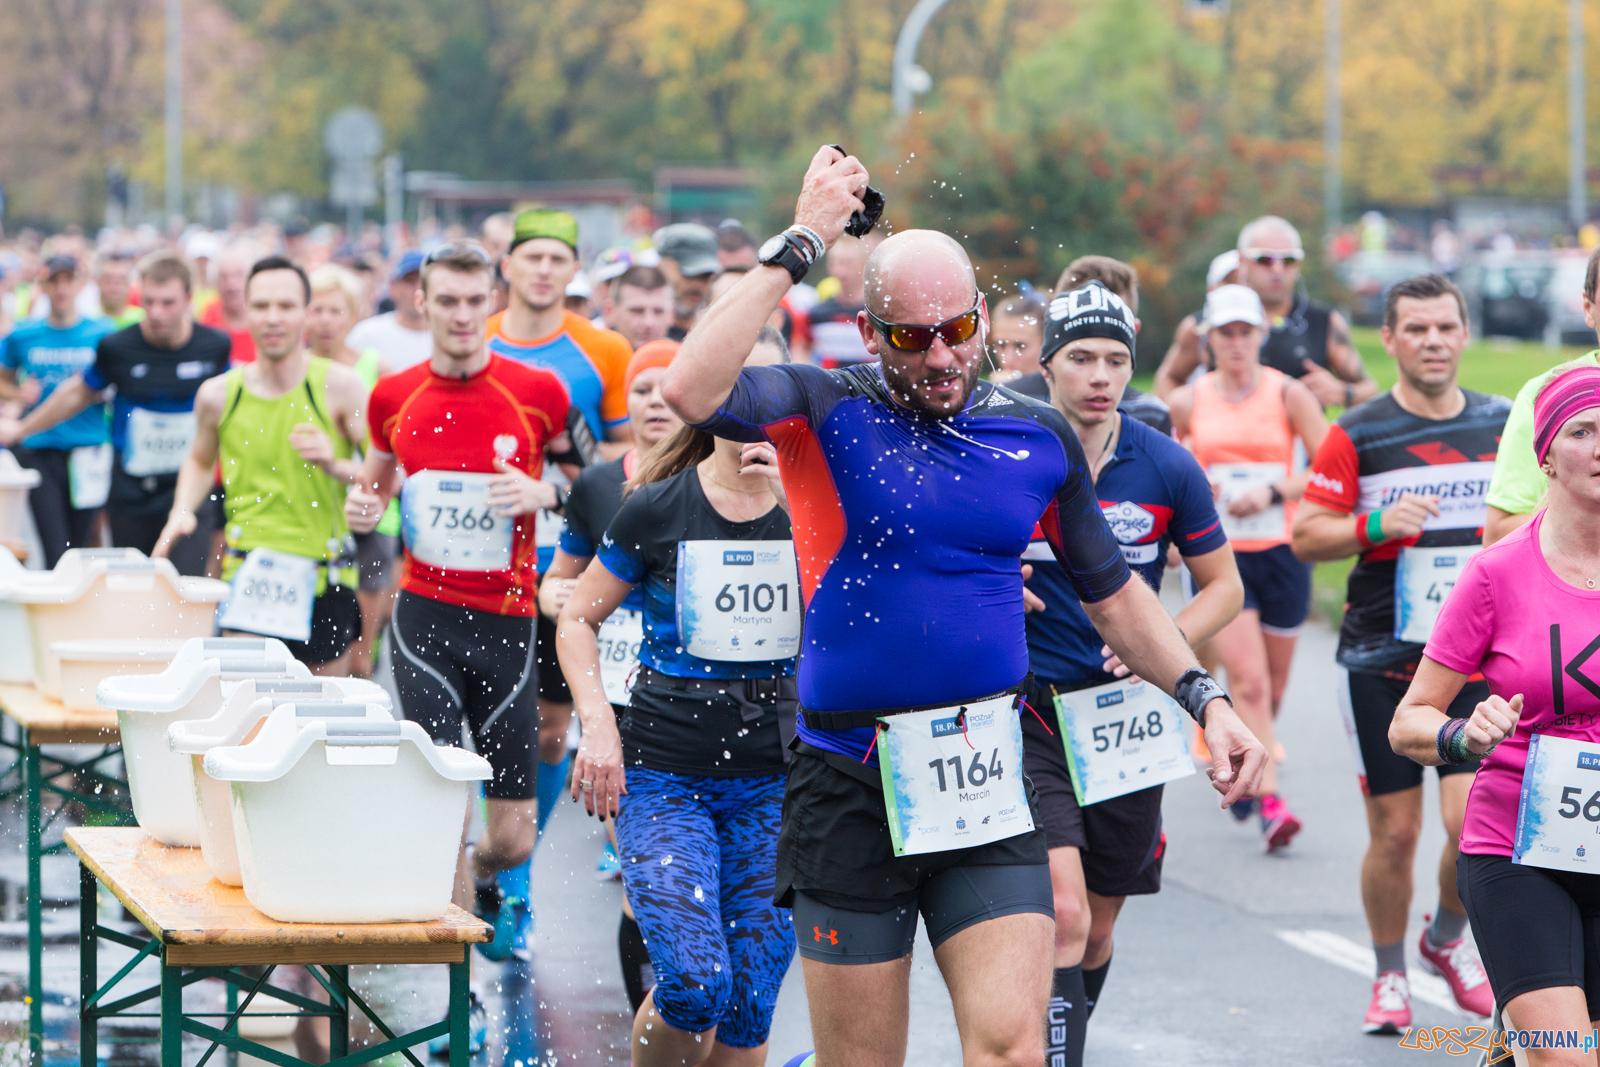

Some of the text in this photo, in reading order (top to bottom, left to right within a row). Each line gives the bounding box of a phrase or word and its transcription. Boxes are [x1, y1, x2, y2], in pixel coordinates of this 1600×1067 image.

[429, 505, 495, 531] 7366
[715, 583, 788, 612] 6101
[733, 616, 773, 625] Martyna
[934, 723, 947, 733] 18.
[1092, 711, 1163, 753] 5748
[928, 747, 1004, 792] 1164
[1581, 756, 1591, 765] 18.
[959, 788, 991, 803] Marcin
[1558, 786, 1600, 822] 56
